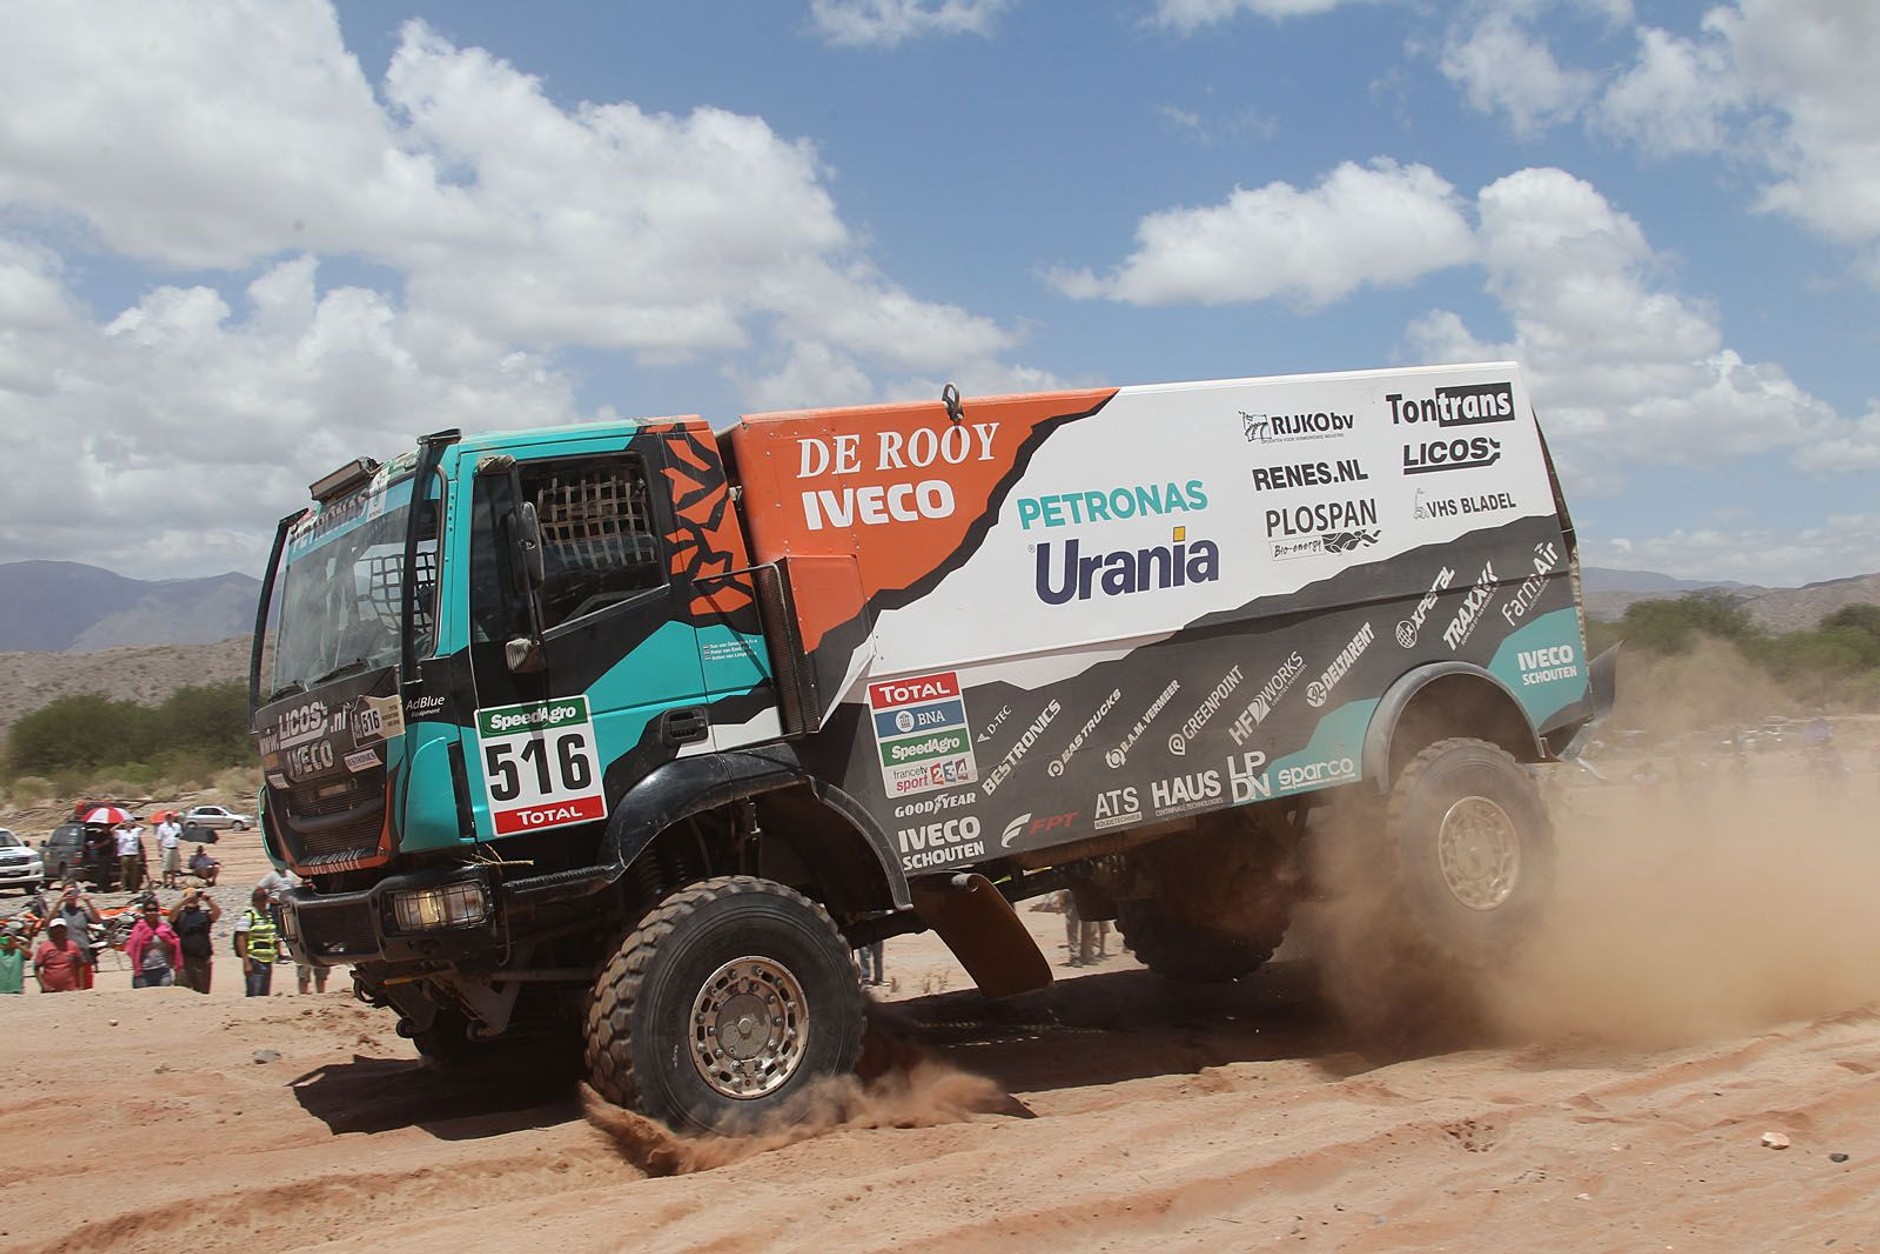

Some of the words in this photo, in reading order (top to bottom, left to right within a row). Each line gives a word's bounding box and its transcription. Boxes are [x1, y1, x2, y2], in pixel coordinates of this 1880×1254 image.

[1385, 392, 1512, 425] Tontrans
[796, 433, 862, 479] DE
[876, 422, 1000, 471] ROOY
[1403, 437, 1490, 467] LICOS
[1252, 459, 1369, 491] RENES.NL
[801, 479, 956, 531] IVECO
[1017, 480, 1209, 530] PETRONAS
[1266, 498, 1378, 537] PLOSPAN
[1426, 499, 1458, 518] VHS
[1460, 492, 1517, 514] BLADEL
[1036, 525, 1219, 606] Urania
[1320, 621, 1375, 691] DELTARENT
[1517, 645, 1575, 671] IVECO
[1261, 651, 1304, 702] WORKS
[1522, 665, 1578, 686] SCHOUTEN
[406, 695, 446, 711] AdBlue
[879, 682, 950, 703] TOTAL
[1142, 679, 1181, 724] VERMEER
[1182, 664, 1244, 740] GREENPOINT
[279, 701, 321, 740] LICOS
[361, 709, 381, 734] 516
[491, 706, 577, 731] SpeedAgro
[917, 710, 946, 726] BNA
[986, 705, 1012, 734] D-TEC
[1062, 735, 1084, 763] BAS
[1080, 688, 1122, 738] TRUCKS
[286, 740, 333, 778] IVECO
[891, 737, 960, 761] SpeedAgro
[982, 698, 1061, 796] BESTRONICS
[485, 733, 593, 802] 516
[896, 774, 928, 792] sport
[1278, 757, 1355, 789] sparco
[895, 791, 977, 818] GOODYEAR
[1094, 786, 1140, 819] ATS
[1151, 769, 1222, 809] HAUS
[517, 806, 583, 826] TOTAL
[1028, 810, 1079, 837] FPT
[897, 815, 981, 853] IVECO
[902, 841, 985, 871] SCHOUTEN
